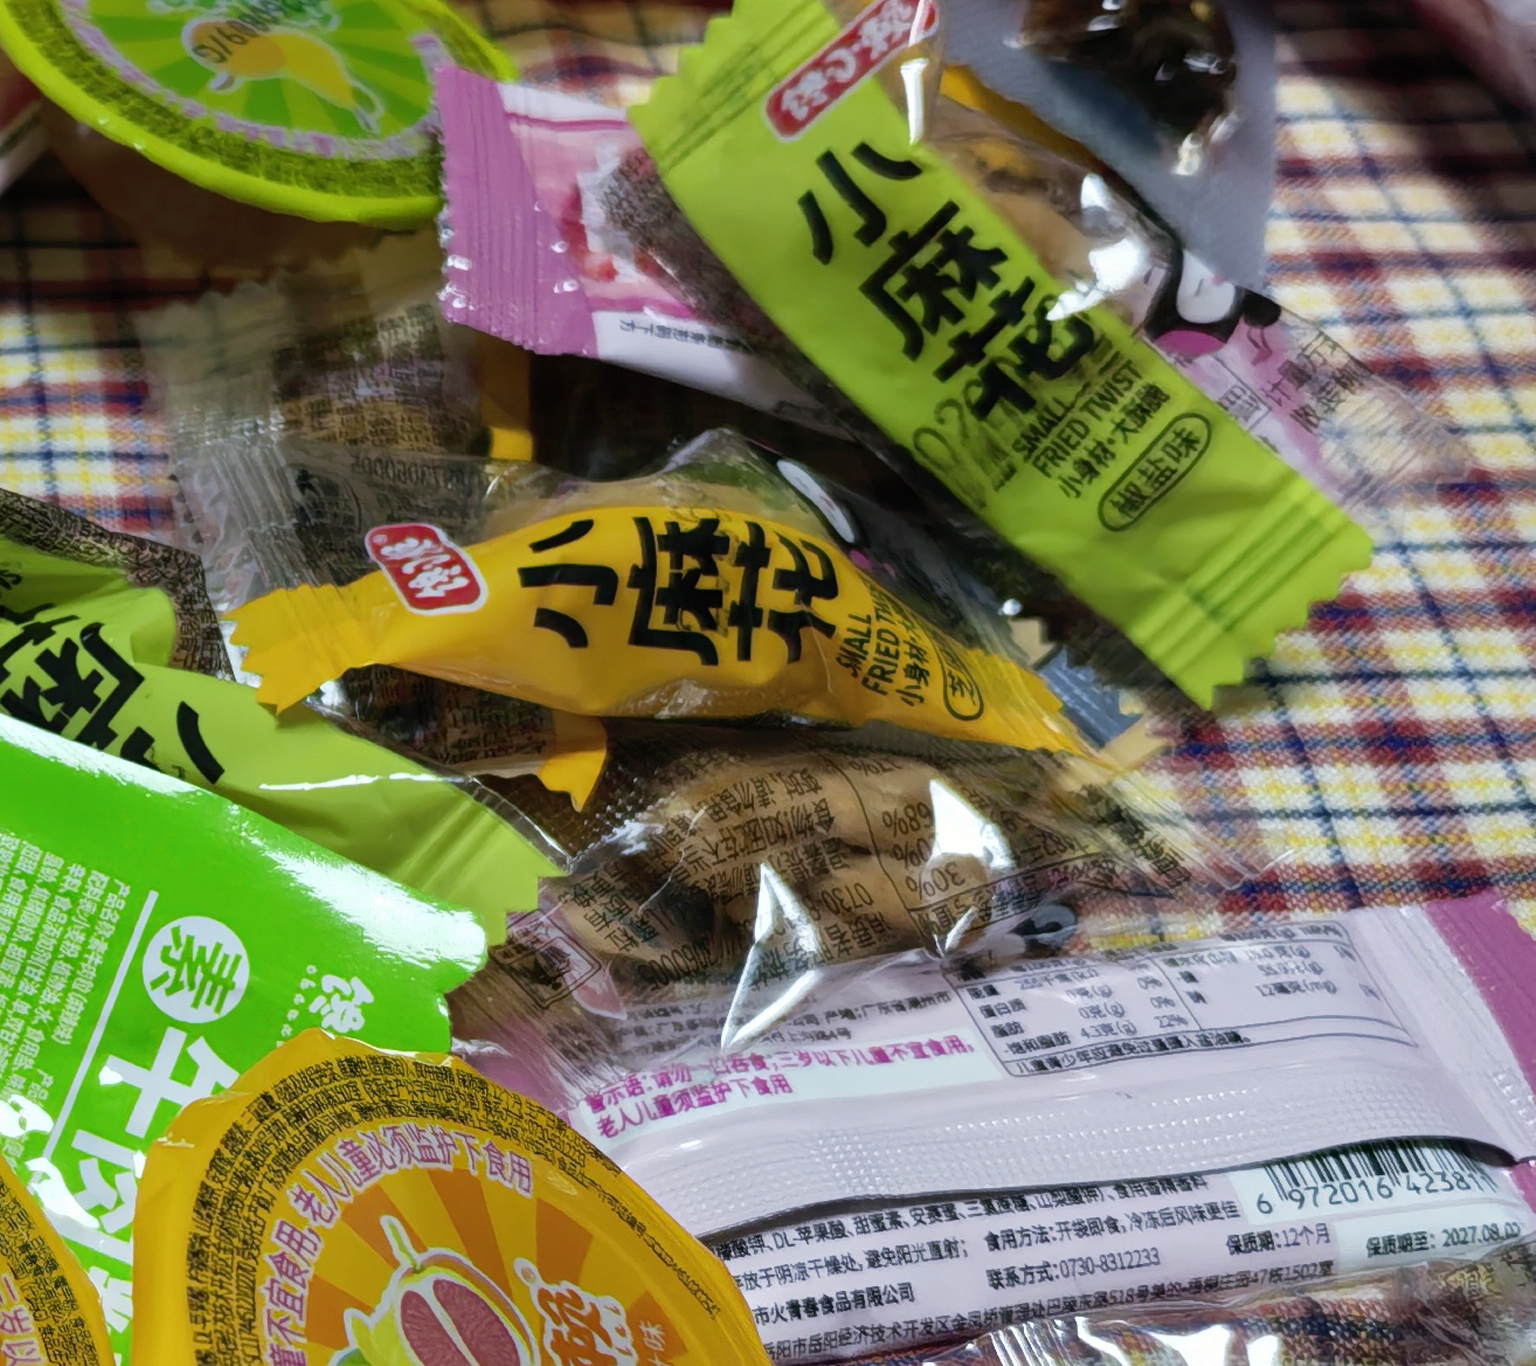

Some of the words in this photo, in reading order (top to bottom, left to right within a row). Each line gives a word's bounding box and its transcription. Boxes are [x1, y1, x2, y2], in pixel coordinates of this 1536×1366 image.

[798, 140, 1097, 423] 小麻花
[1034, 418, 1095, 479] FRIED
[1085, 361, 1144, 427] TWIST
[519, 516, 837, 666] 小麻花
[1255, 1191, 1275, 1216] 6
[1285, 1175, 1396, 1212] 972016
[985, 1246, 1163, 1291] 联系方式:0730-8312233
[1223, 1221, 1332, 1256] 保质期:12个月
